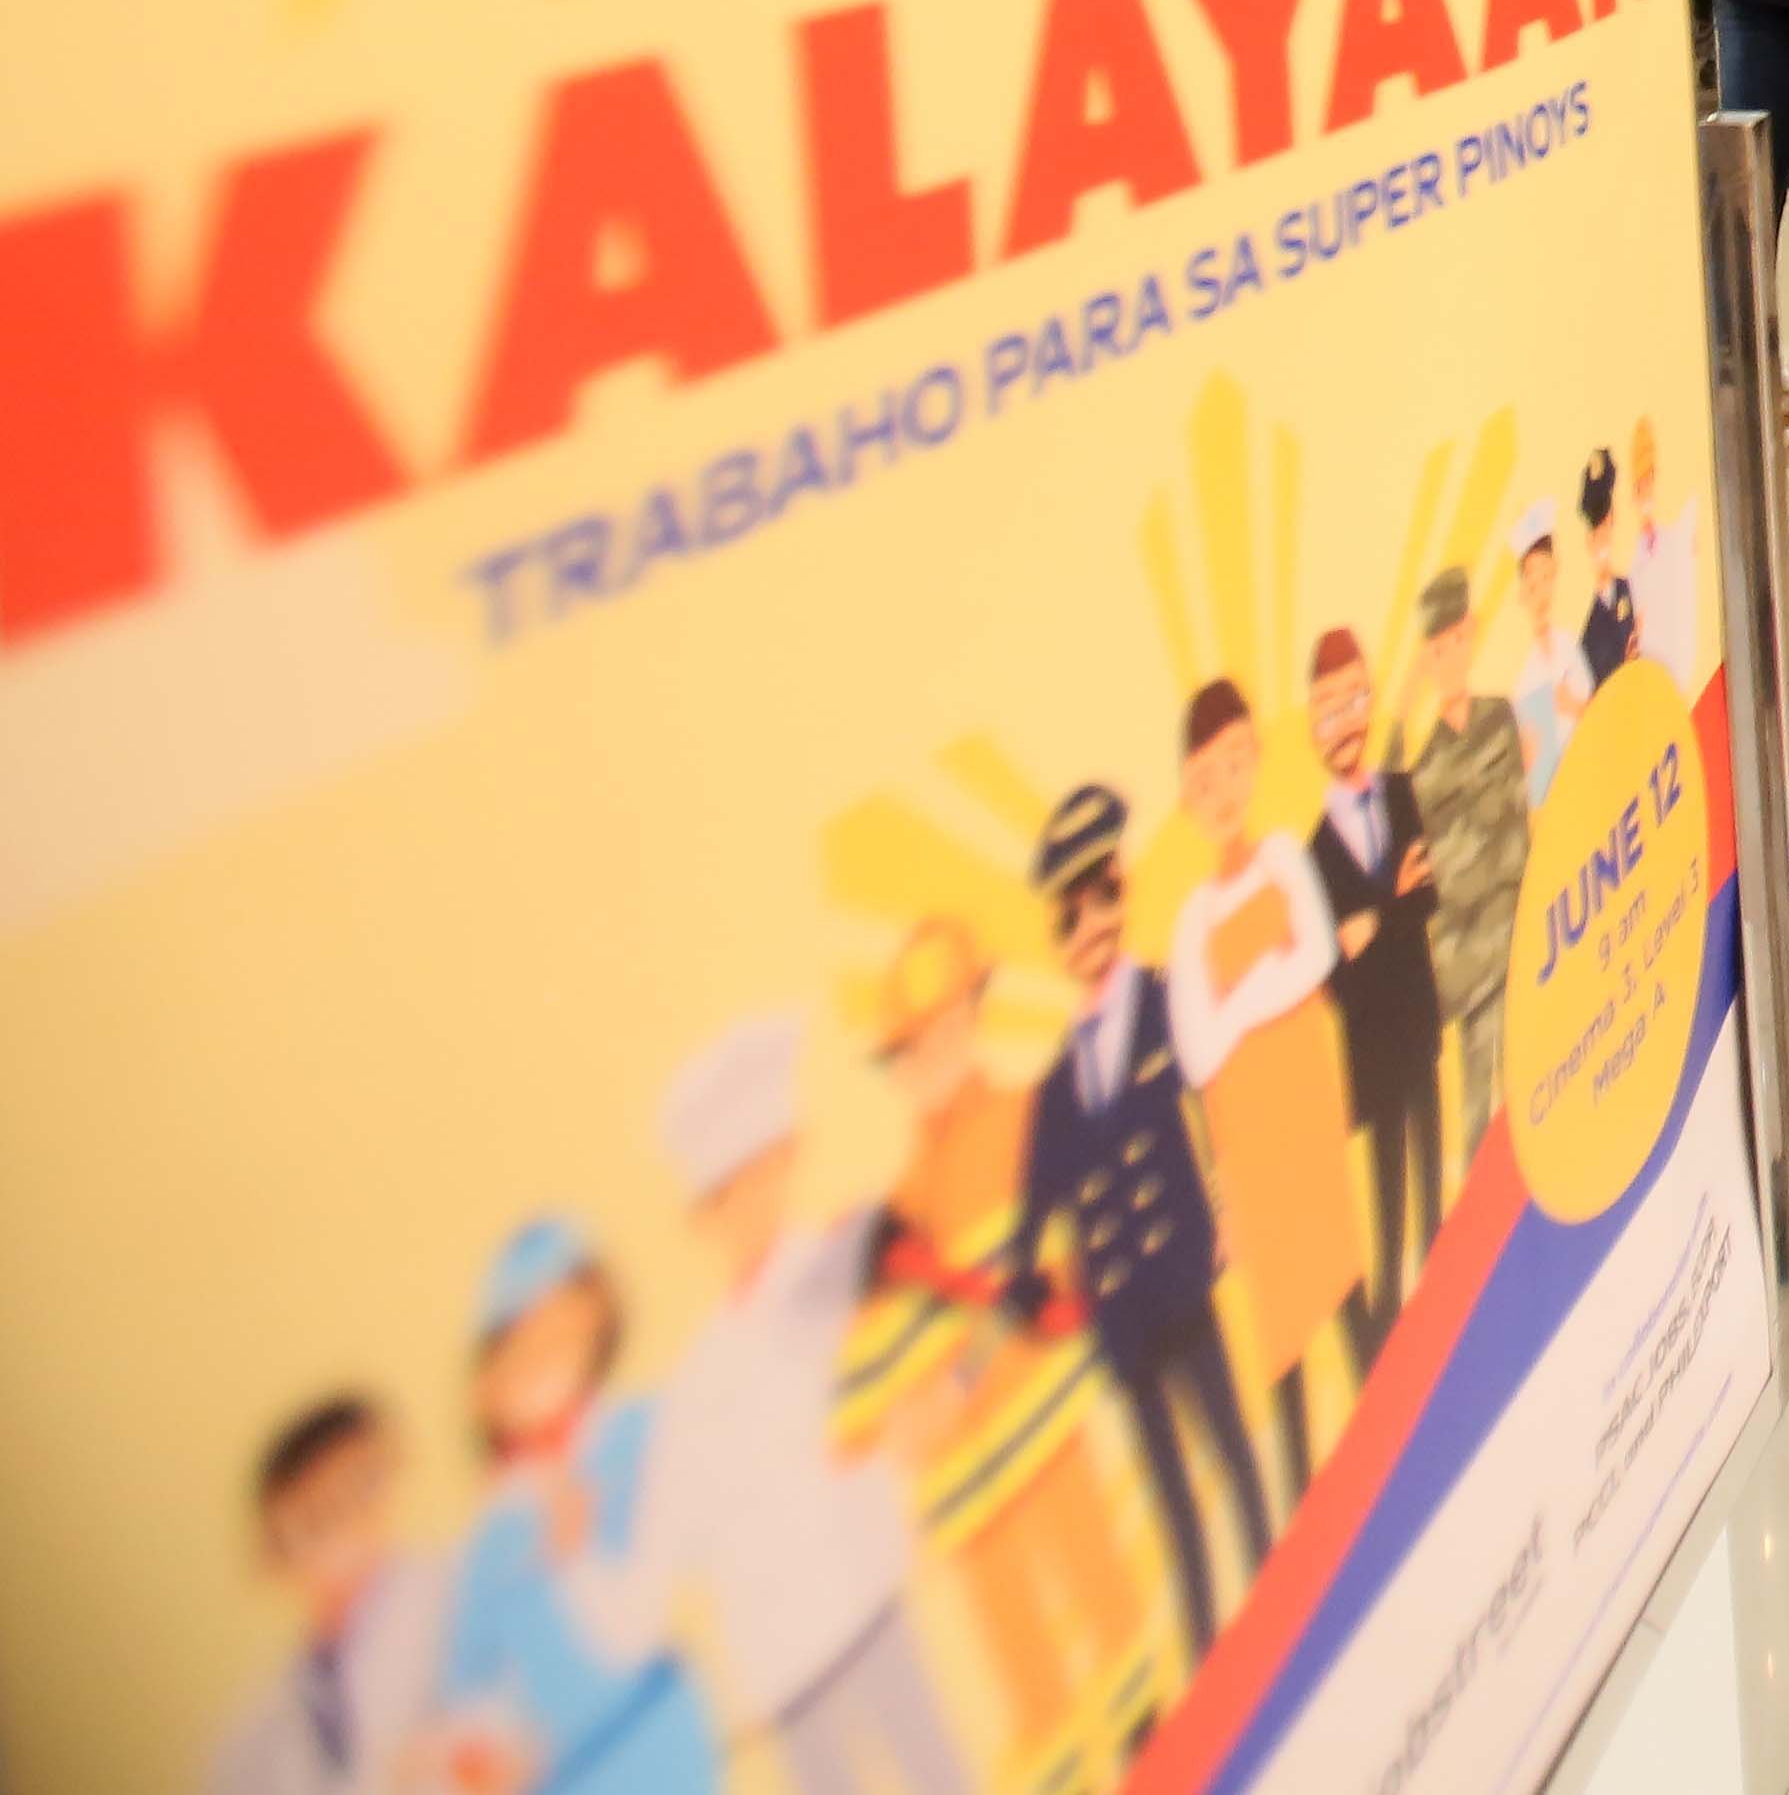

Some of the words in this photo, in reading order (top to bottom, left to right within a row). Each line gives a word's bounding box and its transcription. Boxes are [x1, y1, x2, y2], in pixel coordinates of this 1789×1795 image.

[462, 366, 966, 647] TRABAHO
[985, 273, 1172, 418] PARA
[1184, 233, 1264, 322] SA
[1276, 152, 1444, 279] SUPER
[1456, 79, 1590, 196] PINOYS
[1537, 795, 1644, 986] JUNE
[1650, 741, 1682, 829] 12
[1618, 888, 1647, 947] am
[1529, 1000, 1616, 1128] Cinema
[1644, 884, 1686, 973] Level
[1593, 1013, 1647, 1110] Mega
[1653, 979, 1667, 1021] A
